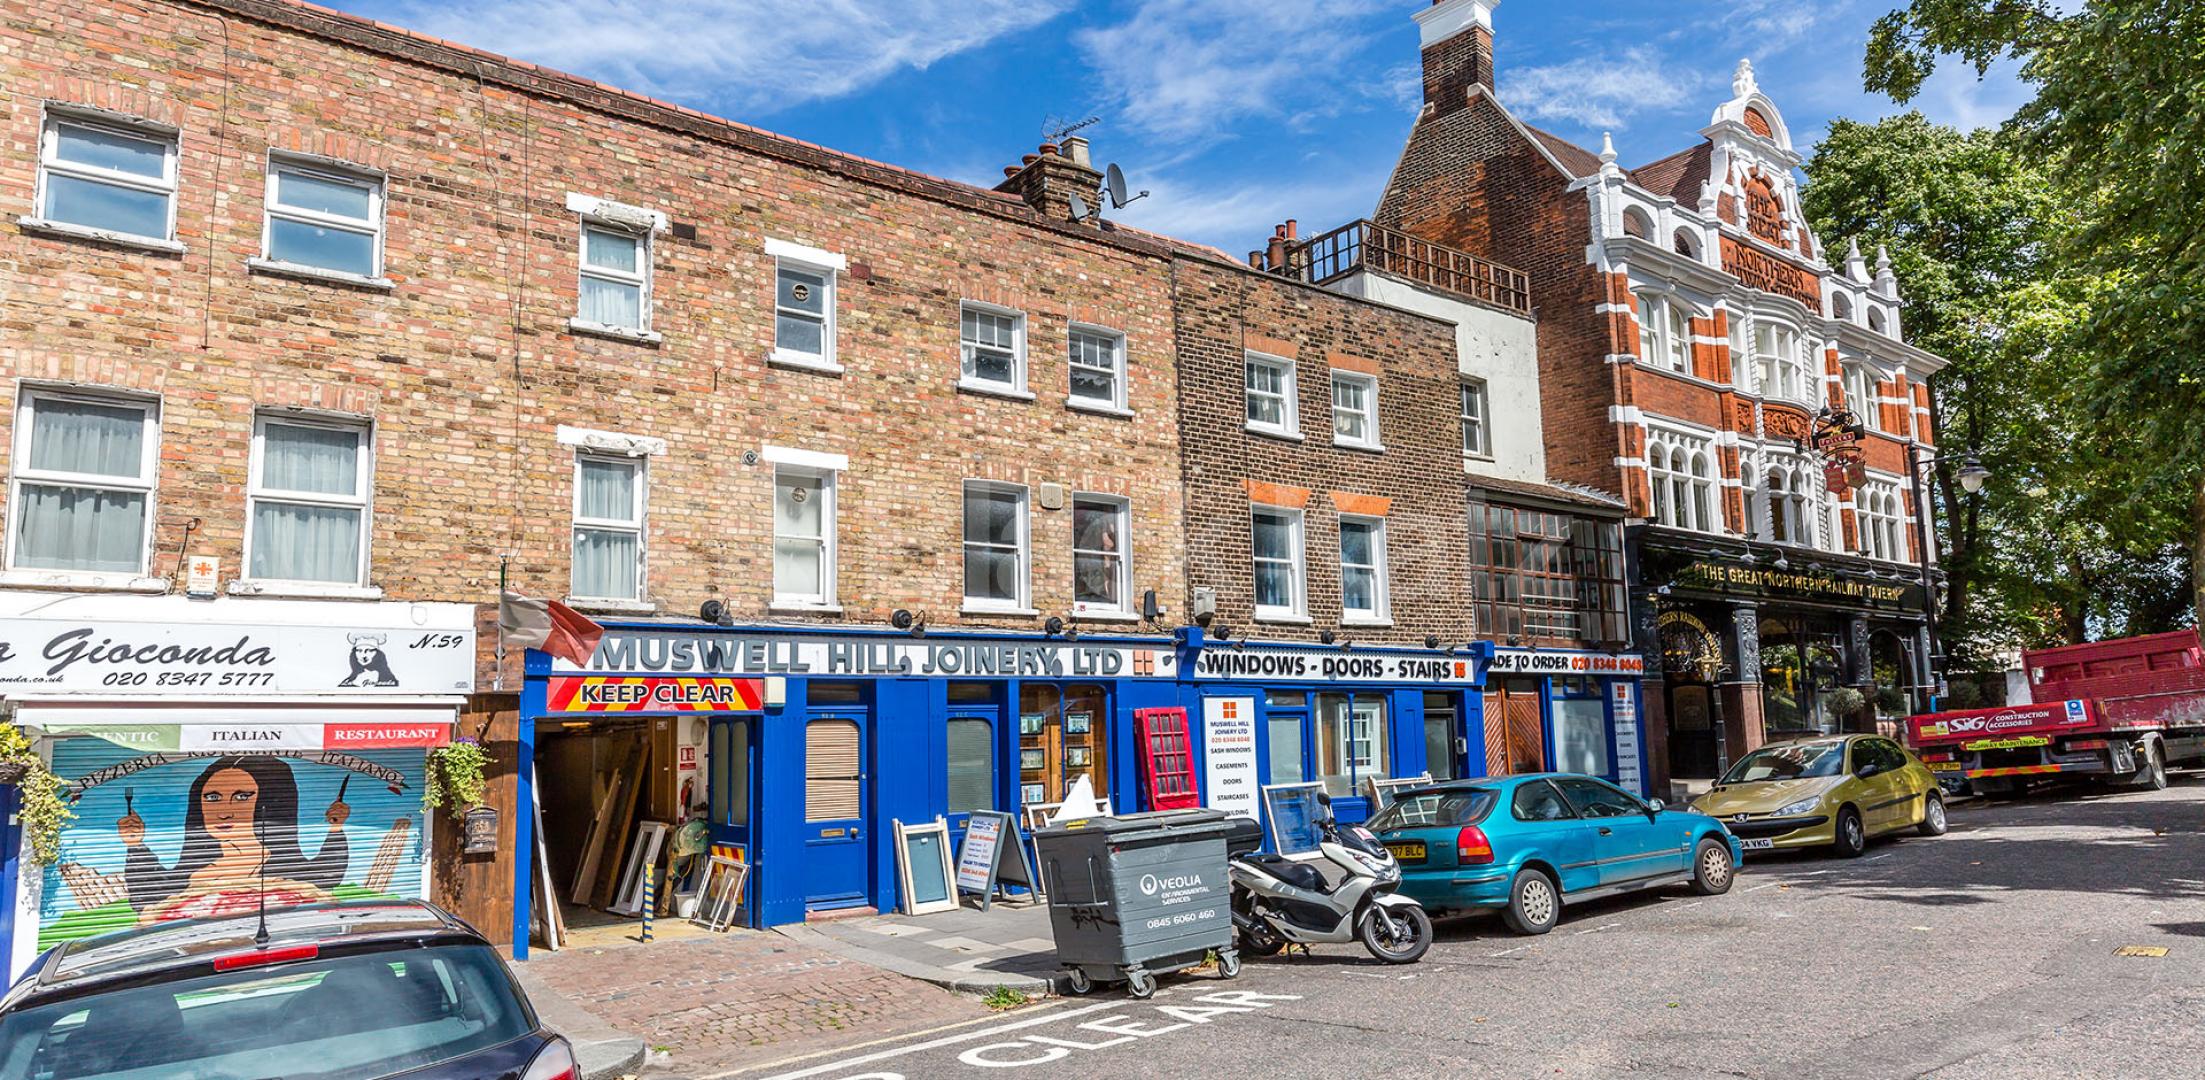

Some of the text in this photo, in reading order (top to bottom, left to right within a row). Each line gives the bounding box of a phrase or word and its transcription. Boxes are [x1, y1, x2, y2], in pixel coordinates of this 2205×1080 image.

[1735, 244, 1804, 290] NORTHERN
[1702, 564, 1899, 600] THE GREAT NORTHERN RAILWAY TAVERN
[42, 627, 276, 676] Gioconda
[593, 636, 1122, 675] MUSWELL HILL JOINERY LTD
[1204, 654, 1305, 676] WINDOWS
[1322, 658, 1384, 678] DOORS
[1398, 660, 1451, 679] STAIRS
[1492, 655, 1512, 669] ADE
[1514, 655, 1530, 669] TO
[1532, 656, 1569, 670] ORDER
[1571, 656, 1590, 670] 020
[1593, 658, 1617, 671] 8348
[0, 672, 274, 686] onda.co.uk 020 8347 5777
[581, 684, 735, 703] KEEP CLEAR
[1989, 719, 2032, 729] ACCESSORIES
[1995, 710, 2050, 722] CONSTRUCTION
[212, 731, 282, 741] ITALIAN
[334, 729, 439, 740] RESTAURANT
[79, 752, 168, 790] PIZZERIA
[320, 751, 399, 782] ITALIANO
[1215, 762, 1248, 770] CASEMENTS
[1217, 793, 1249, 802] STAIRCASES
[1224, 808, 1249, 817] OULDING
[1158, 874, 1201, 890] VEOLIA
[1161, 896, 1191, 906] SERVICES
[1146, 909, 1216, 929] 0845 6060 460
[958, 989, 1303, 1068] CLEAR
